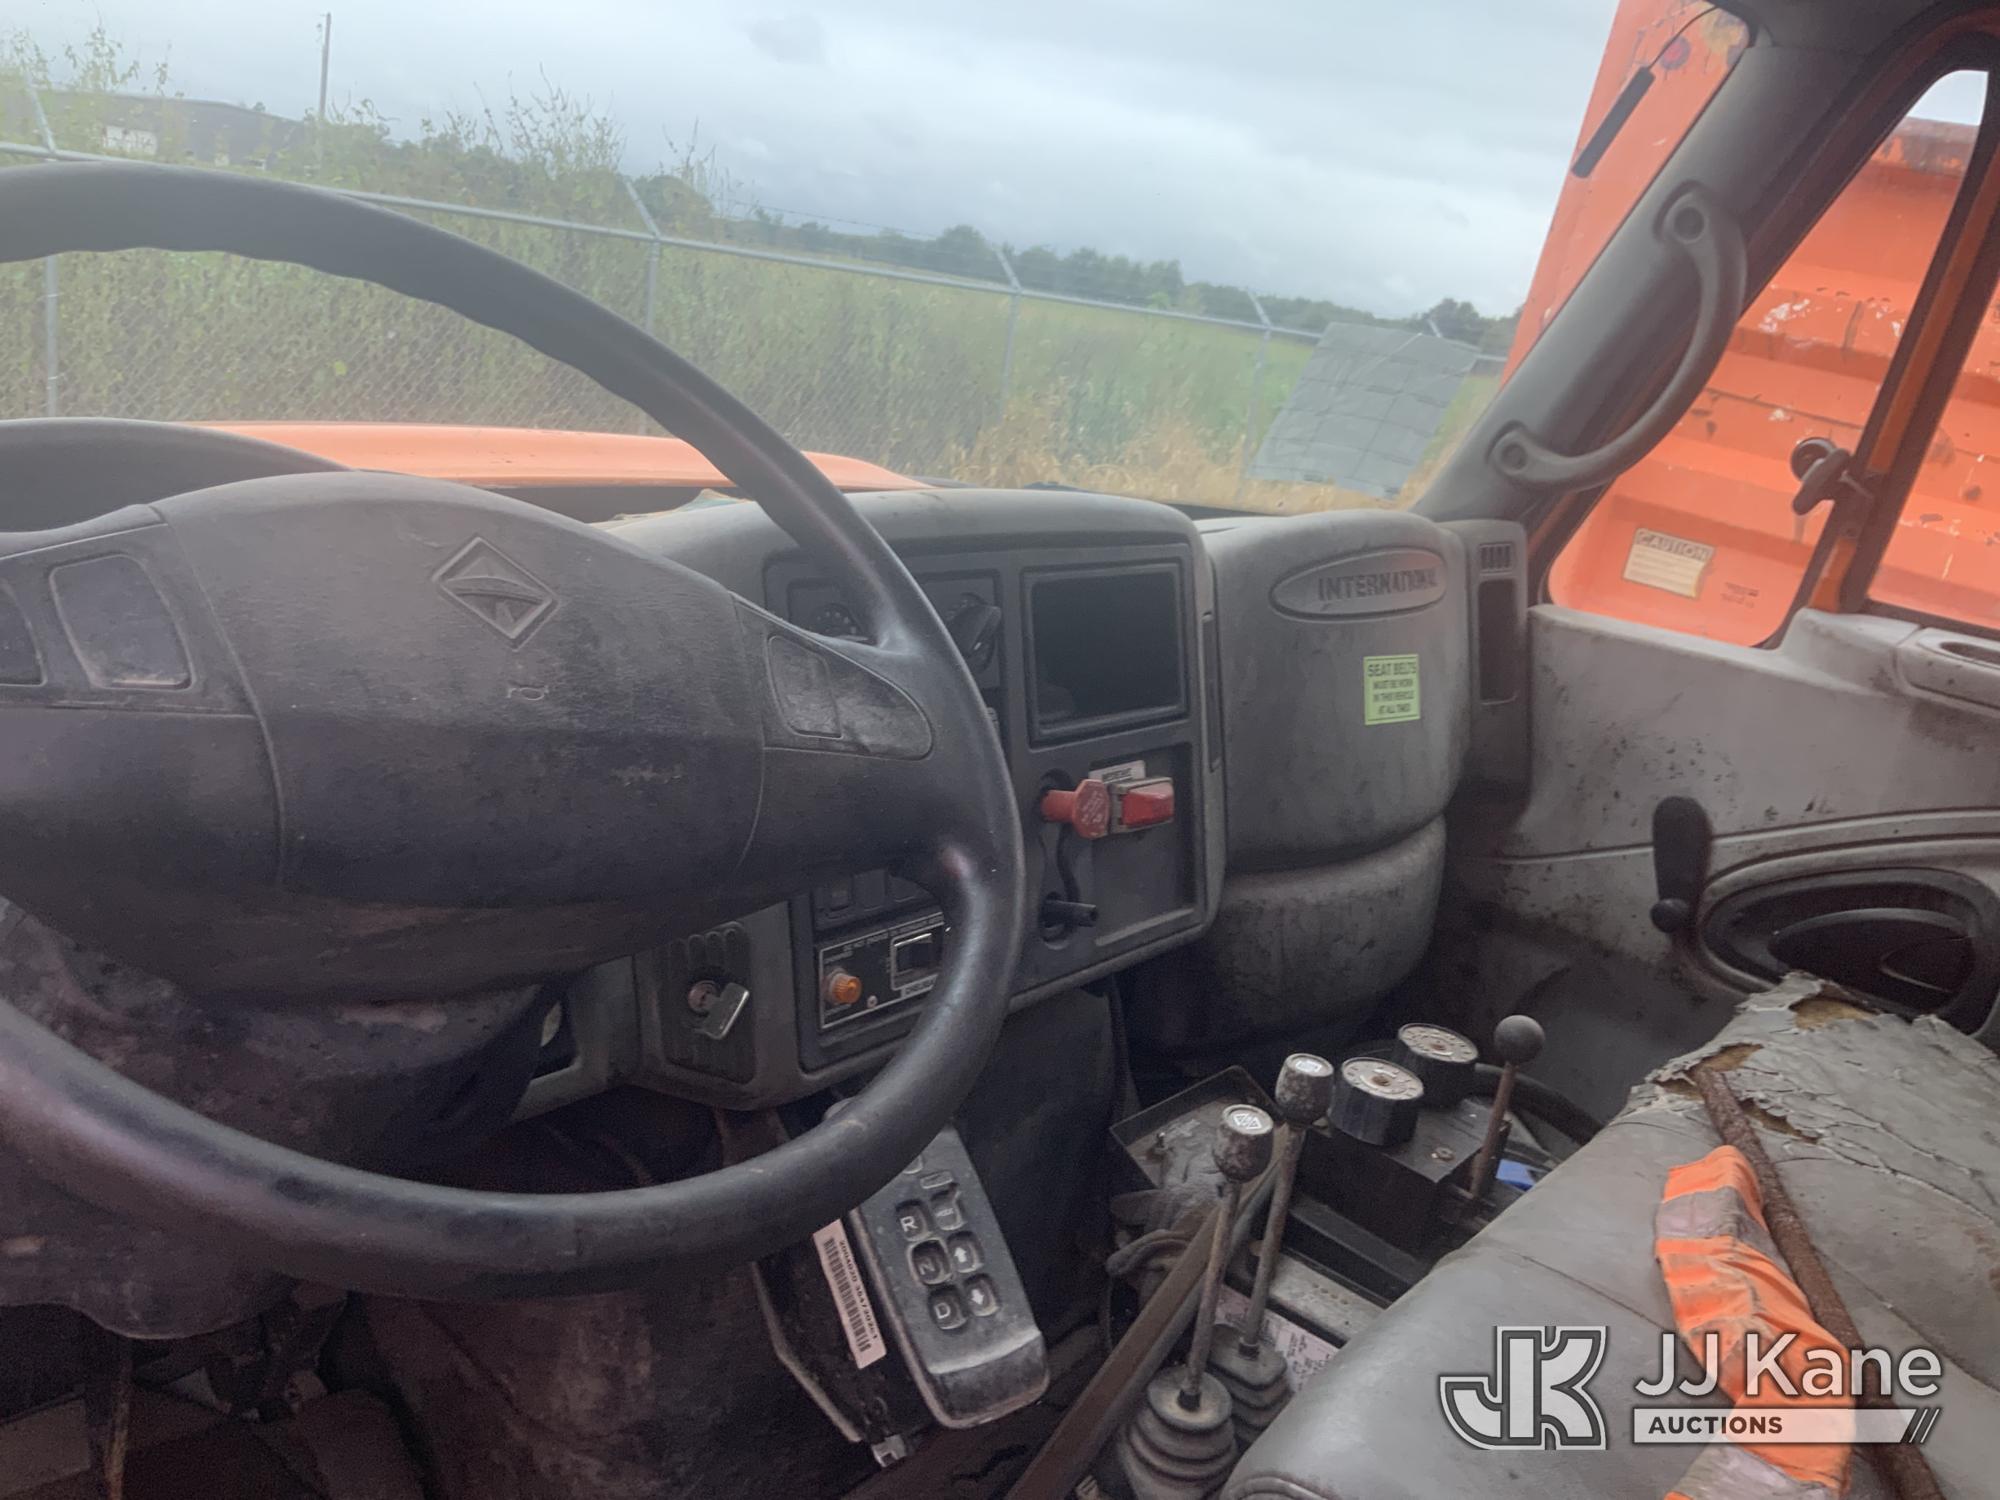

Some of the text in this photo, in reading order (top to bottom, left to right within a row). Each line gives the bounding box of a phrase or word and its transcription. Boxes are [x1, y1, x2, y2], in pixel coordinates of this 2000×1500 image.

[1637, 530, 1711, 562] CAUTION
[1367, 663, 1391, 677] SEAT
[900, 1215, 918, 1232] R
[919, 1257, 937, 1275] N
[934, 1303, 951, 1319] D
